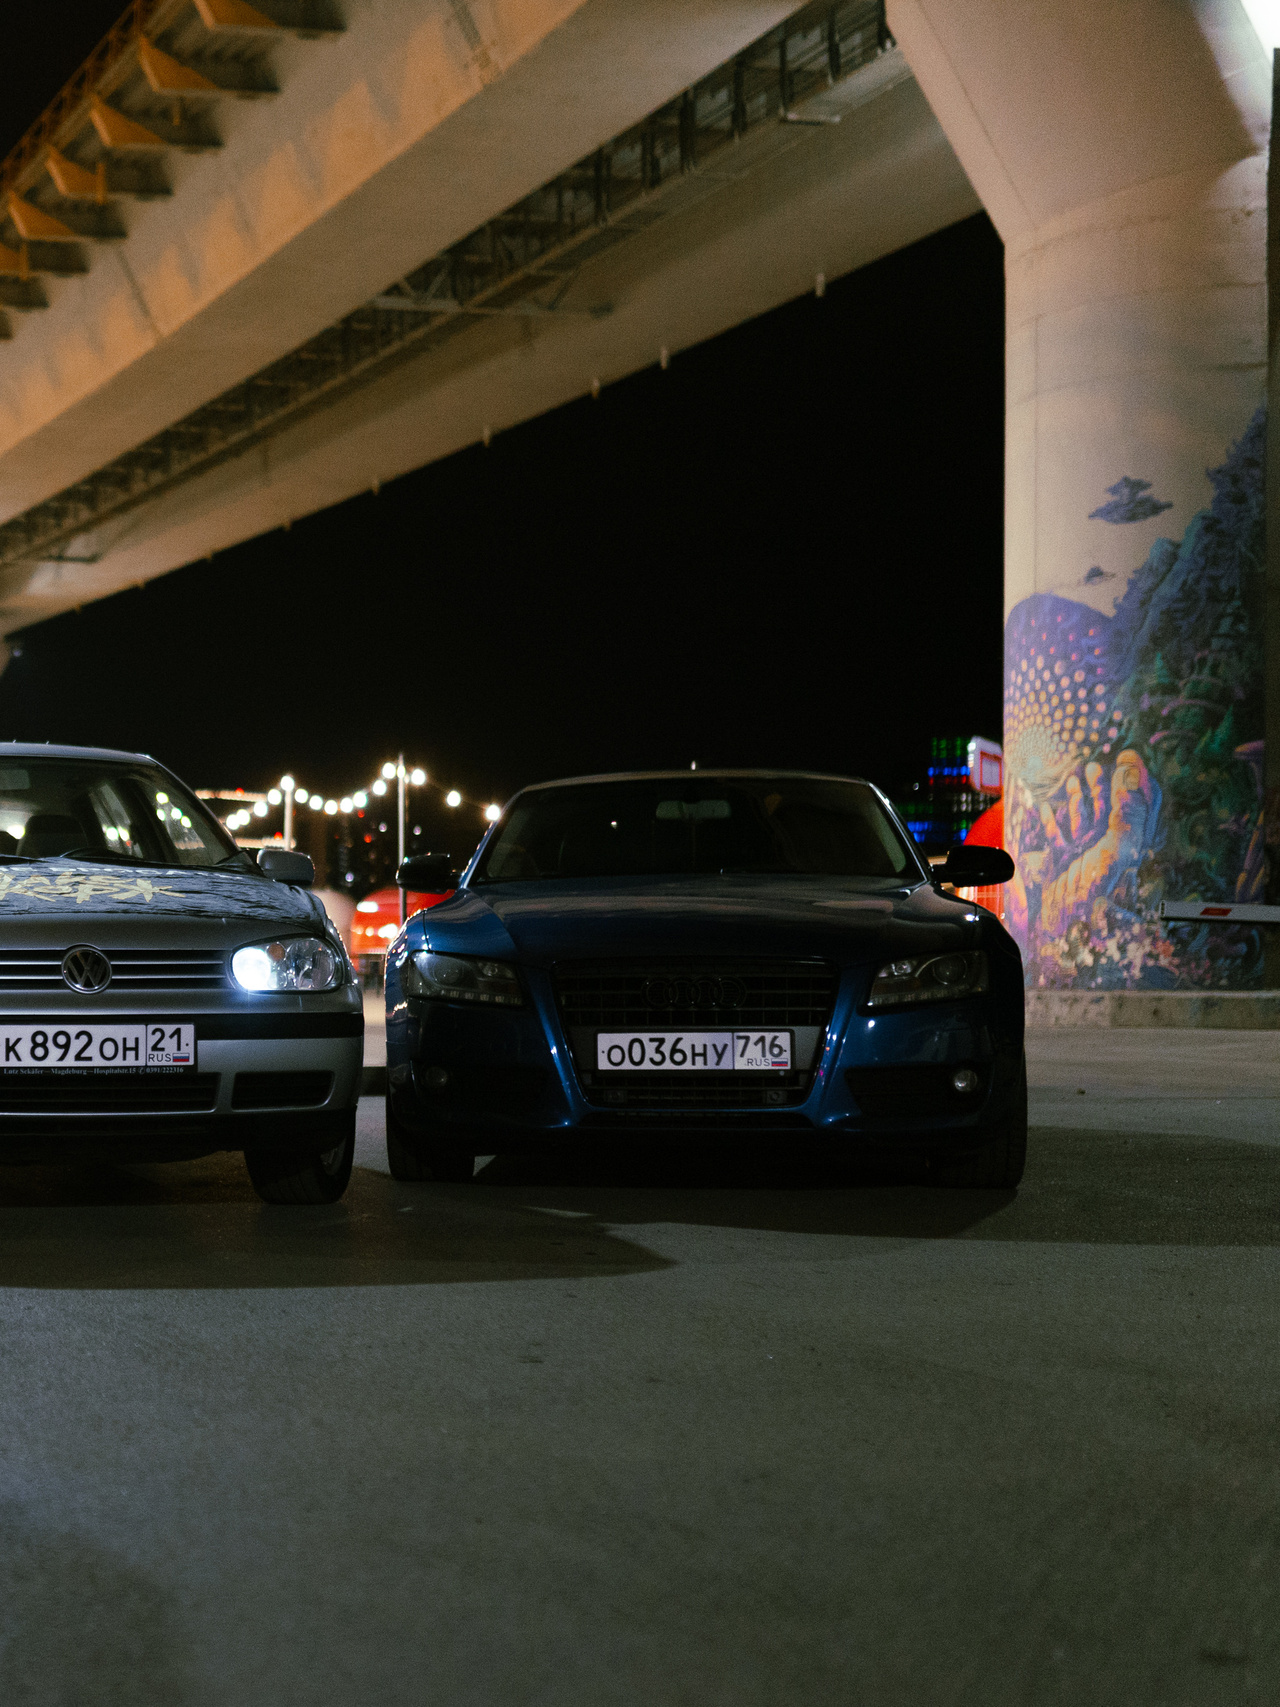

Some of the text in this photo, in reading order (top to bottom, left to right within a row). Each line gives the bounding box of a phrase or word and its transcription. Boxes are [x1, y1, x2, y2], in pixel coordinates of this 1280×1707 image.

[4, 1027, 182, 1062] К892ОН 21
[606, 1035, 784, 1067] О036НУ 716
[148, 1053, 171, 1062] RUS
[747, 1058, 770, 1067] RUS
